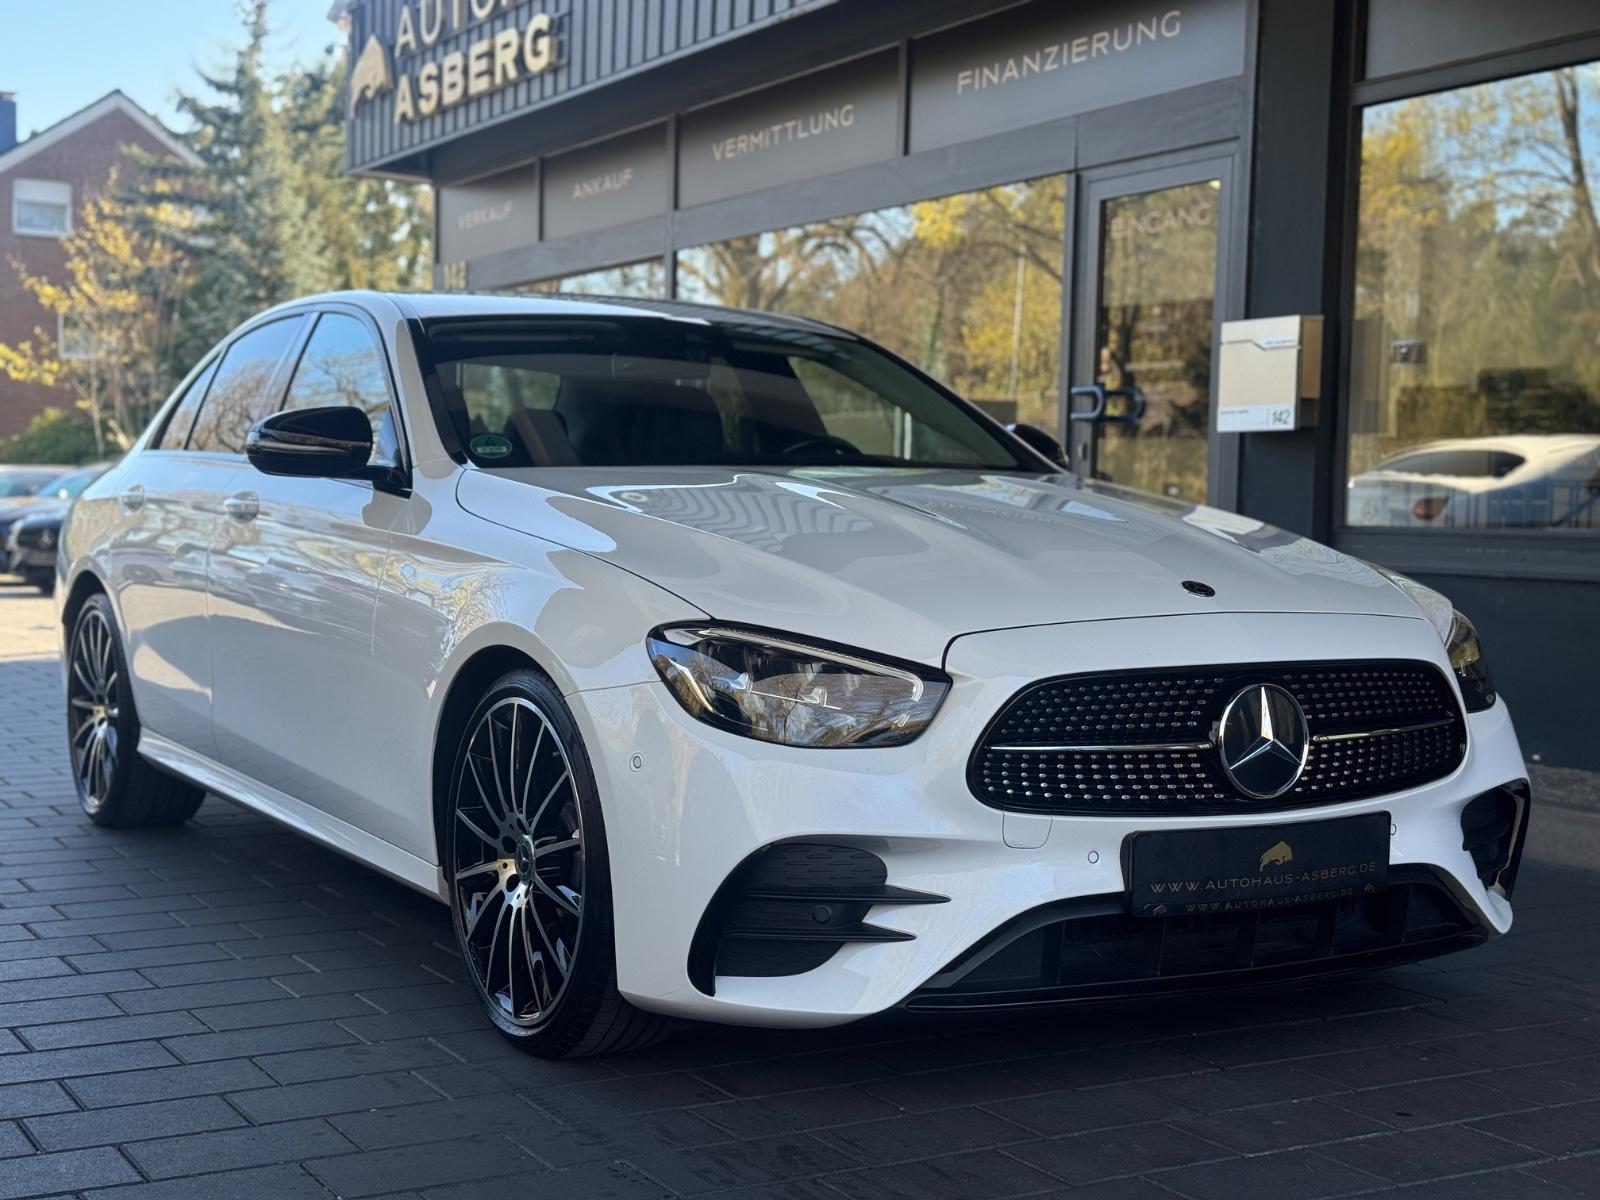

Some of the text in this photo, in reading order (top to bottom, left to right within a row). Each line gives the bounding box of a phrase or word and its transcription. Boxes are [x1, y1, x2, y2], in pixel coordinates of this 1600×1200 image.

[394, 13, 554, 124] ASBERG
[957, 10, 1181, 94] FINANZIERUNG
[712, 104, 854, 161] VERMITTLUNG
[572, 167, 633, 200] ANKAUF
[1271, 408, 1292, 425] 142
